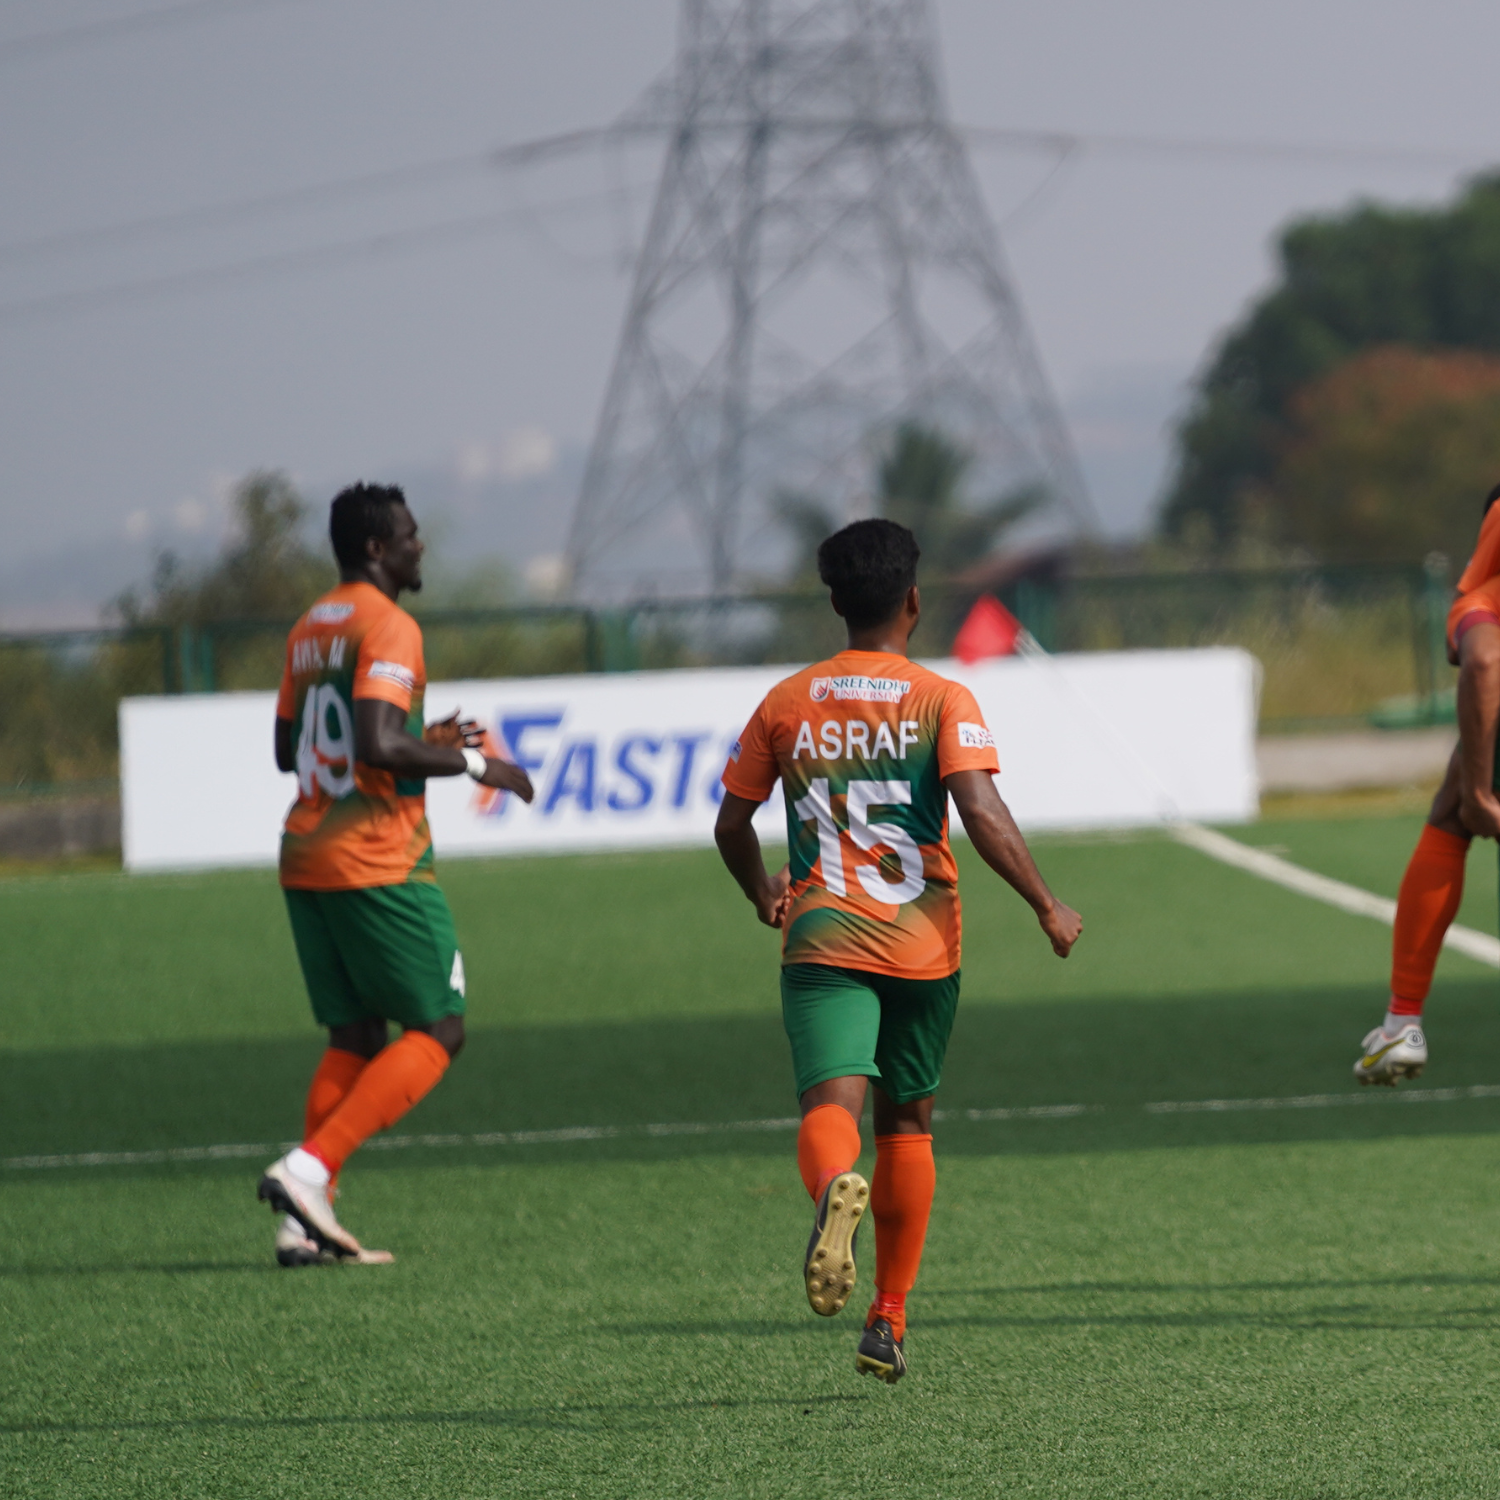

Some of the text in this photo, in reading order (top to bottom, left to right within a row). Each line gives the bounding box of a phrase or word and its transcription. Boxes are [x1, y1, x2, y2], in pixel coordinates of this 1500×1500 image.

[832, 677, 910, 693] SREENIDHI
[296, 682, 356, 801] 49
[793, 720, 919, 760] ASRAF
[794, 777, 926, 905] 15
